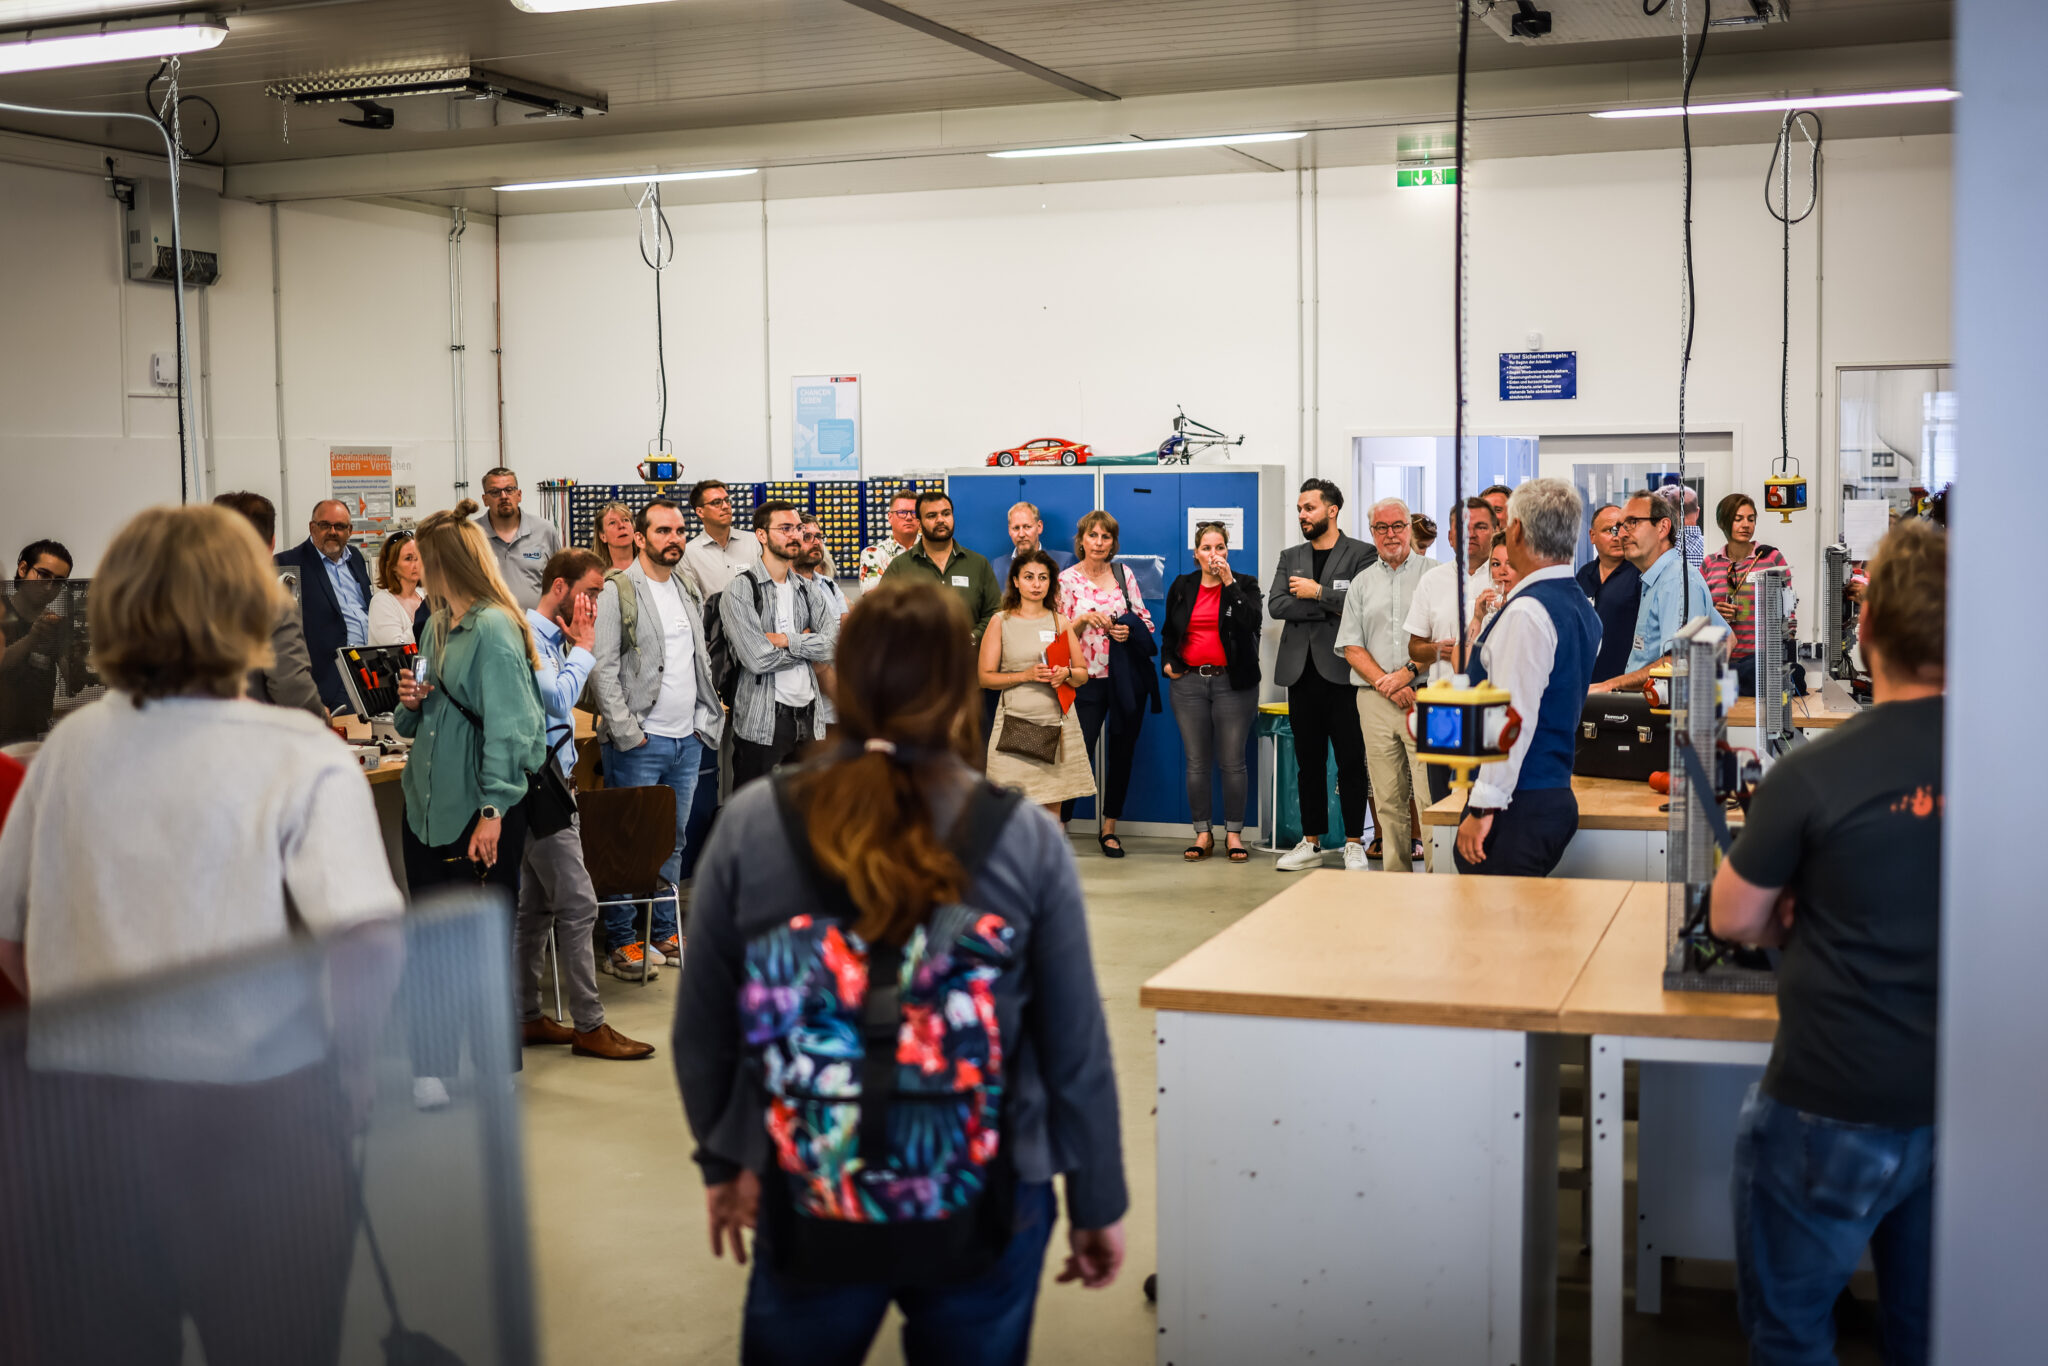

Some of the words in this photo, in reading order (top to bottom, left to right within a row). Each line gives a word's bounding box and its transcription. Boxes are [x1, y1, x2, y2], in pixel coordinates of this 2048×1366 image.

[1522, 352, 1569, 360] Sicherheitsregeln:
[331, 461, 361, 471] Lernen
[370, 460, 412, 471] Verstehen
